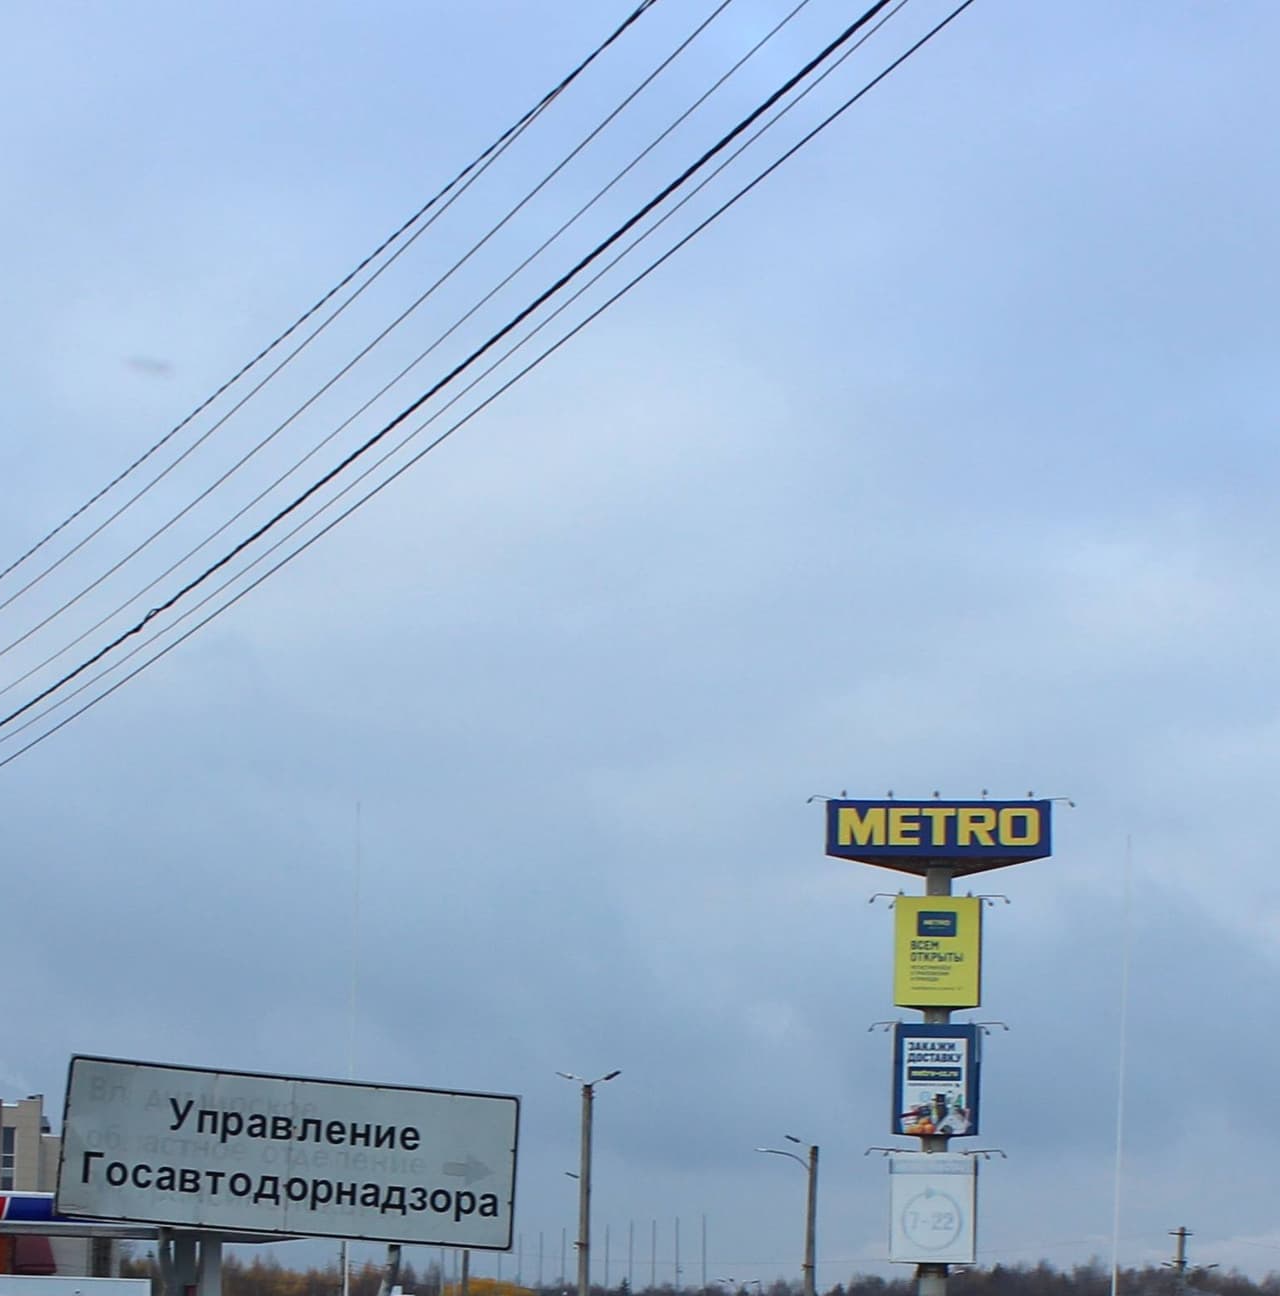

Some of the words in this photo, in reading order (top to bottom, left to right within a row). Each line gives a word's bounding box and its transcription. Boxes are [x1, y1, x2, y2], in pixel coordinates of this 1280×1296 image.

[838, 808, 1040, 846] METRO
[911, 940, 939, 950] ВСЕМ
[910, 952, 964, 962] ОТКРЫТЫ
[908, 1042, 956, 1051] ЗАКАЖИ
[907, 1053, 962, 1063] ДОСТАВКУ
[169, 1097, 421, 1151] Управление
[81, 1151, 499, 1222] Госавтодорнадзора
